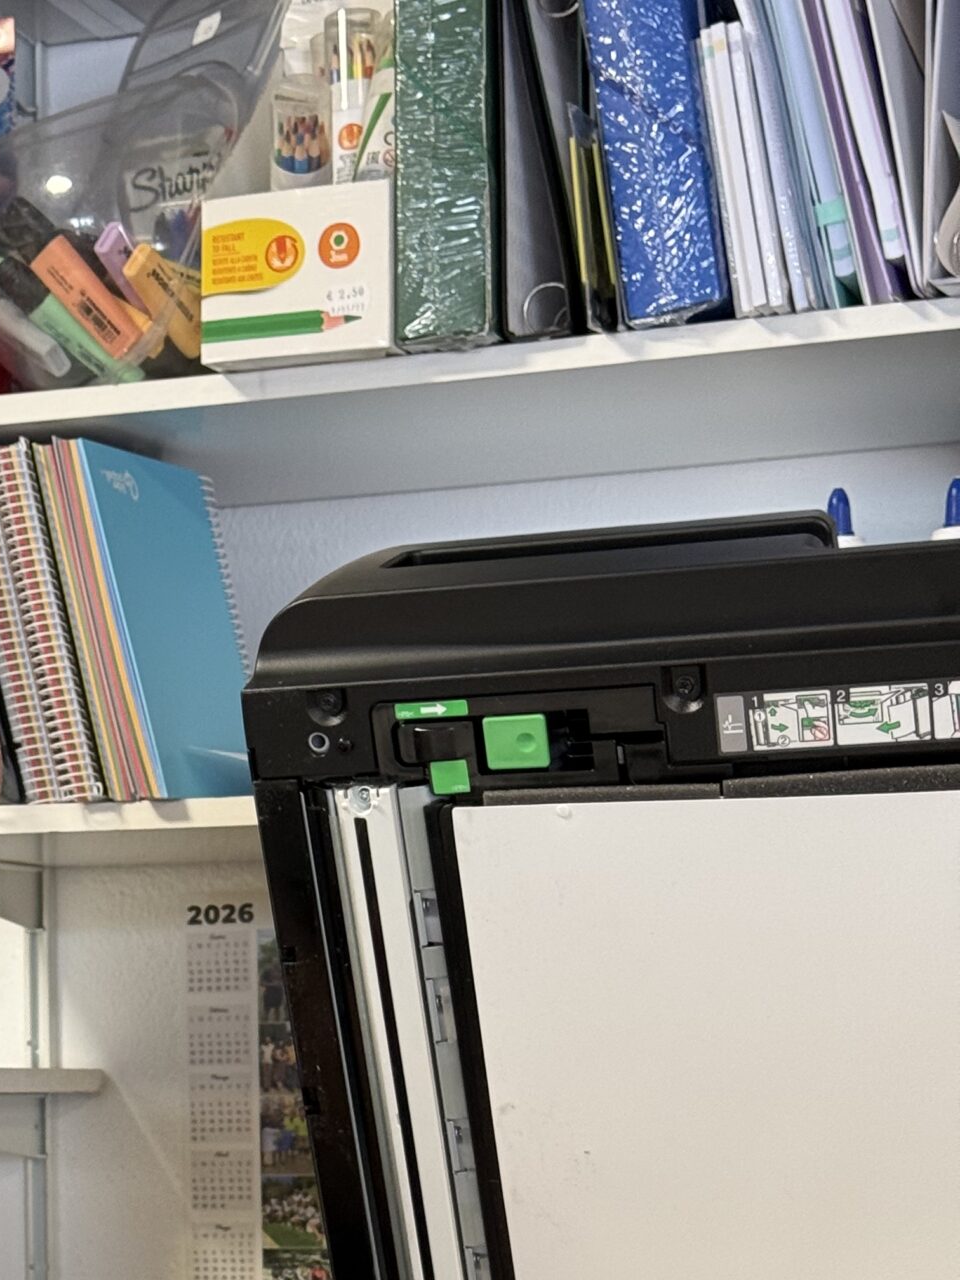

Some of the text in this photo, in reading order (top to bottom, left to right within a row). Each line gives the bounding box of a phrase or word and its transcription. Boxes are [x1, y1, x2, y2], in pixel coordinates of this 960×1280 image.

[934, 683, 944, 695] 3
[751, 696, 758, 707] 1
[836, 690, 846, 702] 2
[187, 902, 255, 926] 2026
